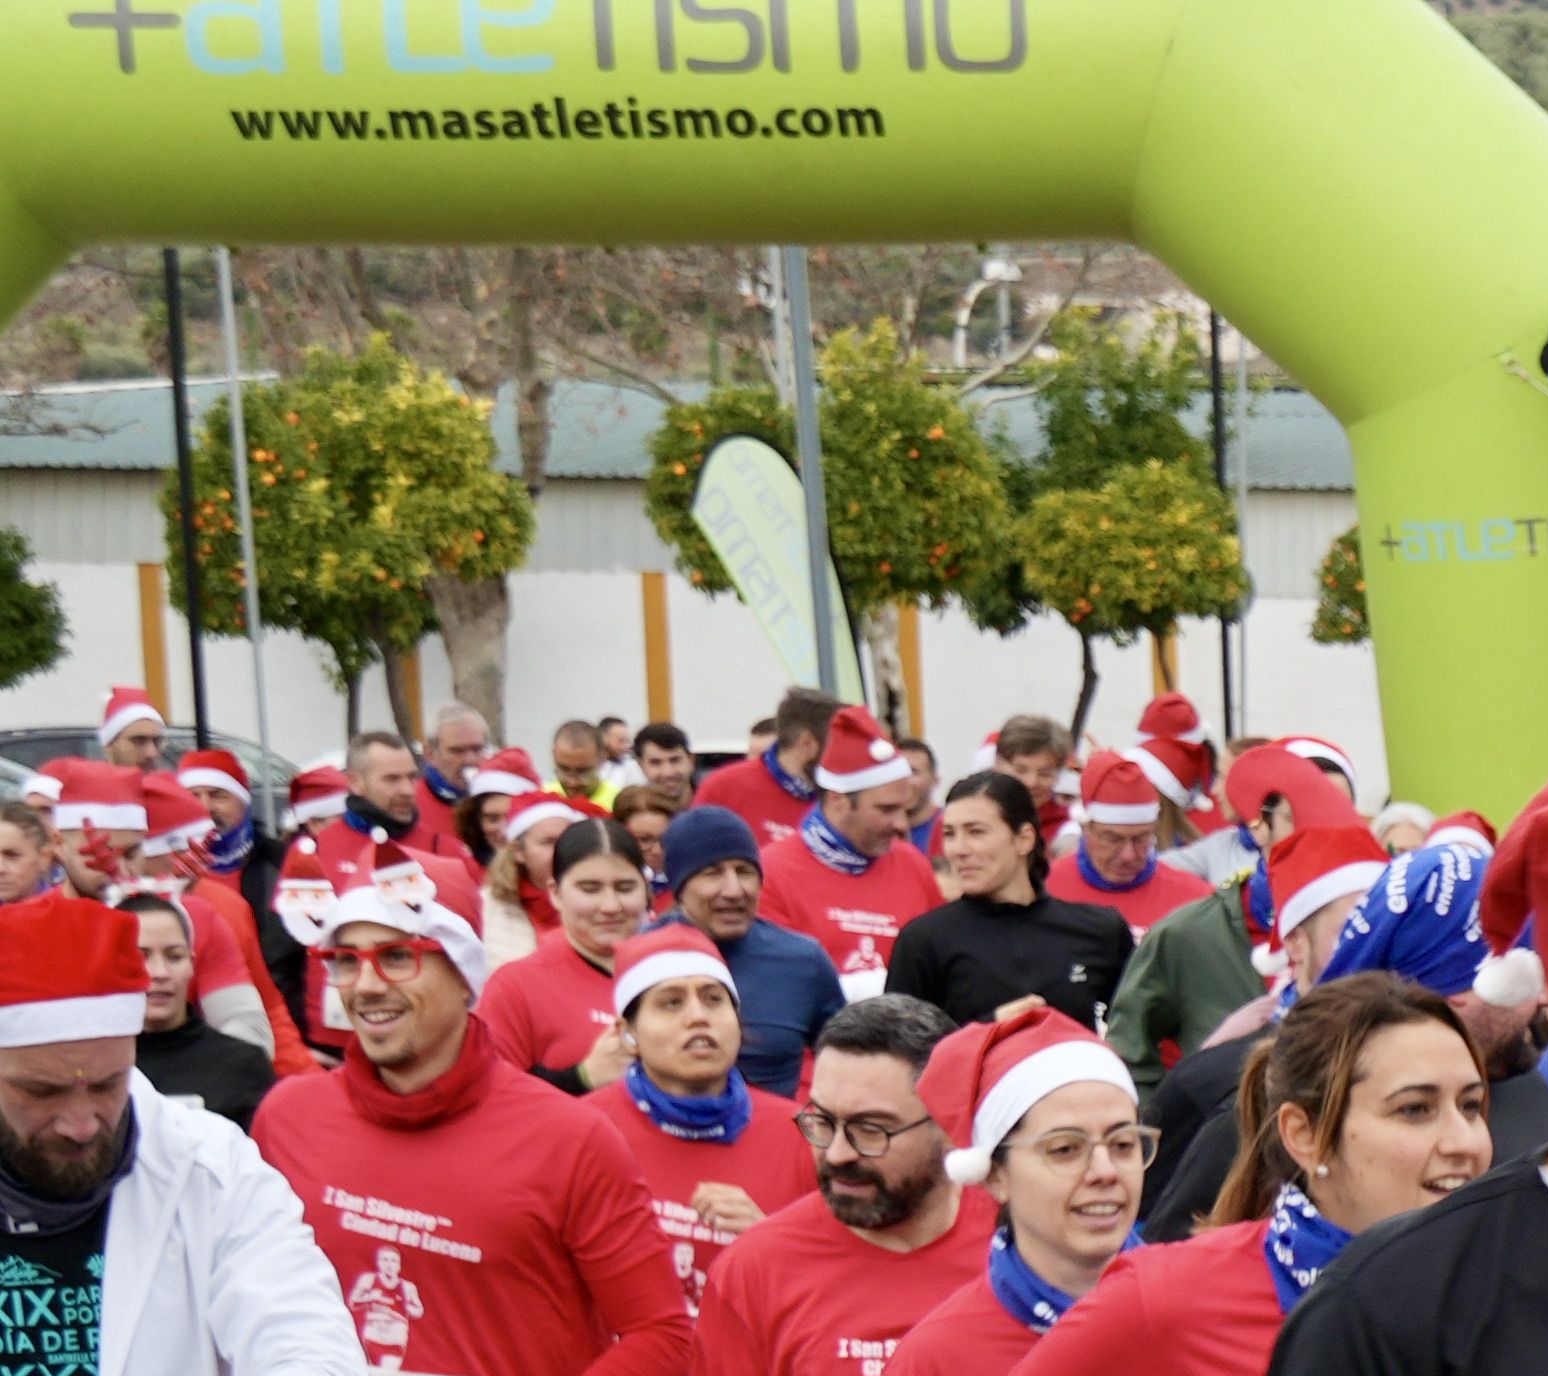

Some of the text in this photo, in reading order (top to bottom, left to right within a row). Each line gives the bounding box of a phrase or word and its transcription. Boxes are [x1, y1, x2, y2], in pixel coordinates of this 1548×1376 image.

[230, 98, 885, 141] www.masatletismo.com
[334, 1187, 366, 1213] San
[365, 1196, 438, 1232] Silvestre
[341, 1211, 482, 1264] Ciudad de Lucena
[41, 1329, 81, 1352] DE
[850, 1337, 883, 1358] San
